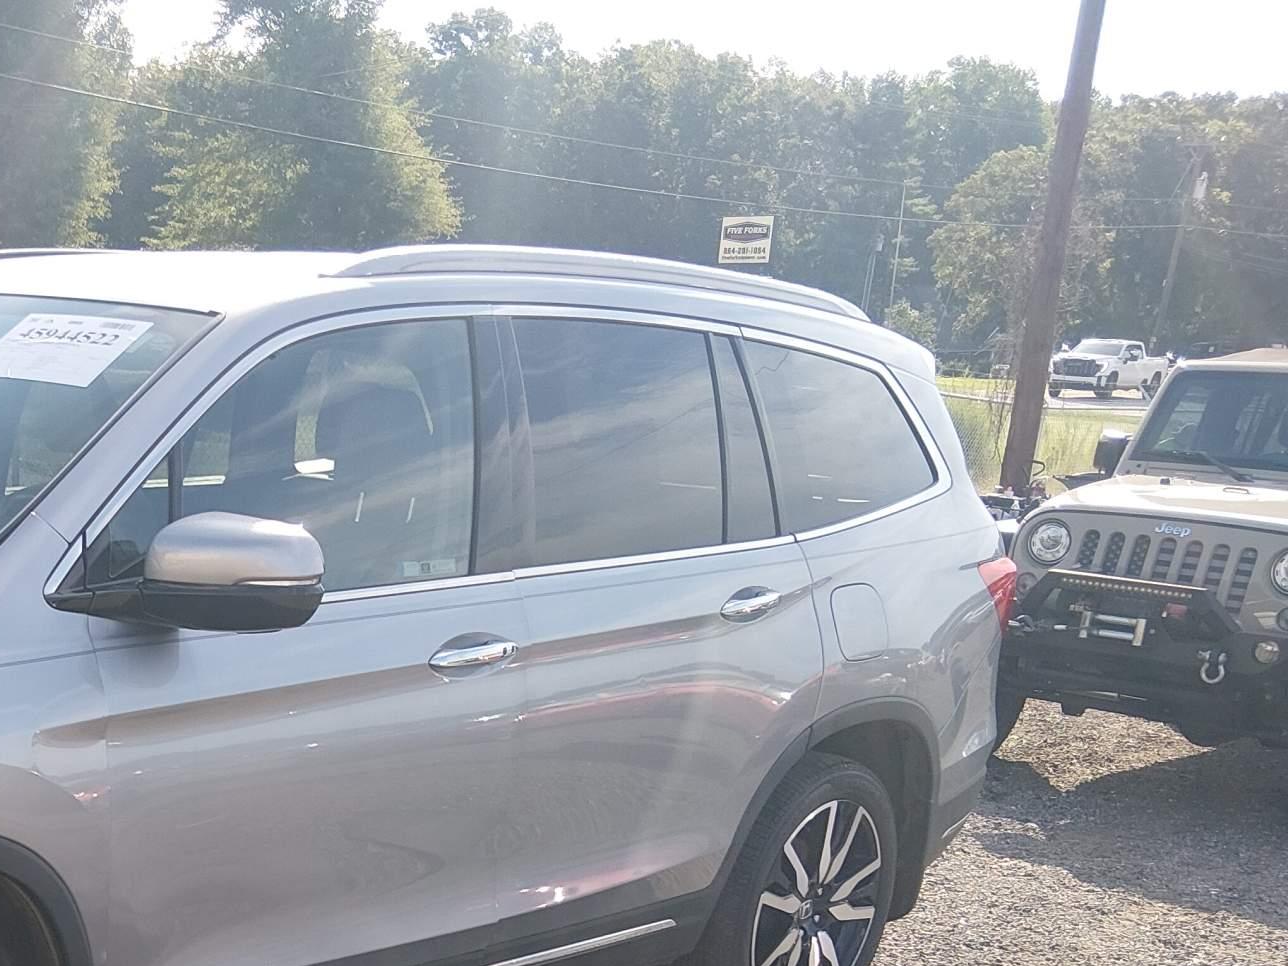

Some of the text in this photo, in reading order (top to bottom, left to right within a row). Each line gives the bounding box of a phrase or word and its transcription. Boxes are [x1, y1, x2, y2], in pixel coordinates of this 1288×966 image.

[744, 226, 767, 234] FORKS
[19, 327, 120, 346] 45944522
[1154, 522, 1191, 537] Jeep
